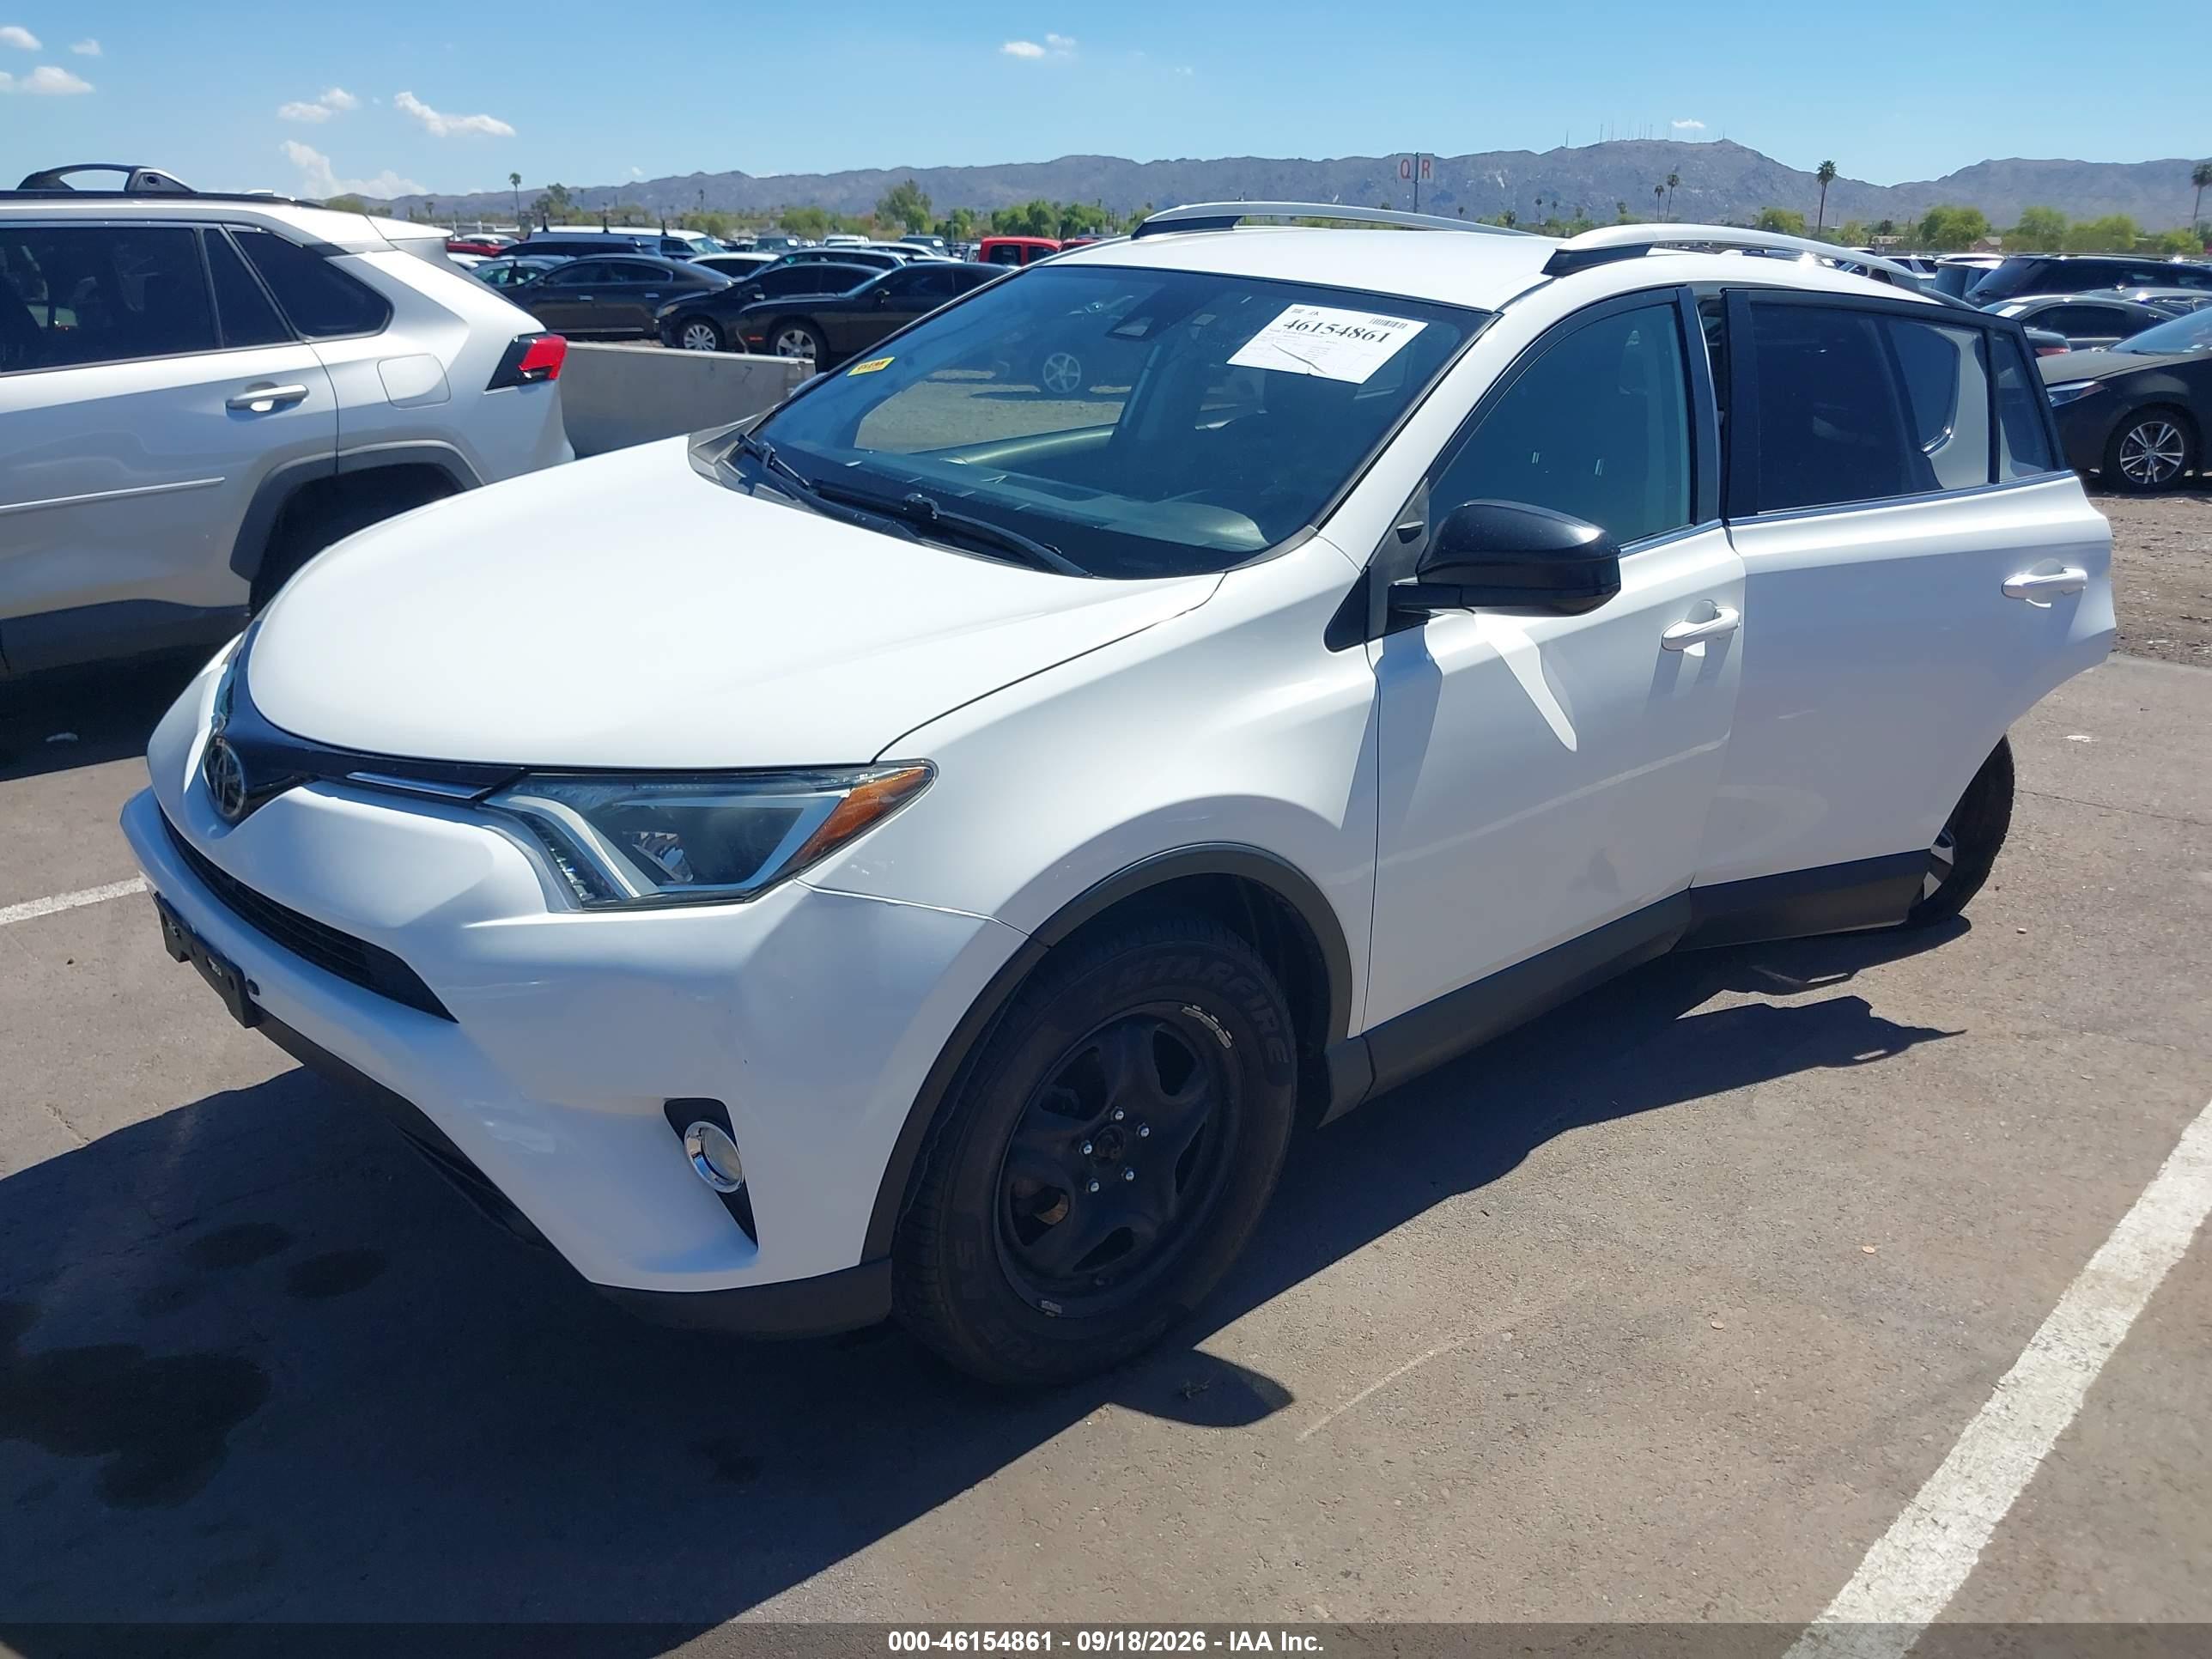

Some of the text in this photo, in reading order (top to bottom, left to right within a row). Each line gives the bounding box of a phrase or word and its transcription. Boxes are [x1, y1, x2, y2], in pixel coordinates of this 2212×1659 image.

[1400, 159, 1411, 179] Q
[1421, 159, 1431, 179] R
[1282, 319, 1392, 343] 46154861
